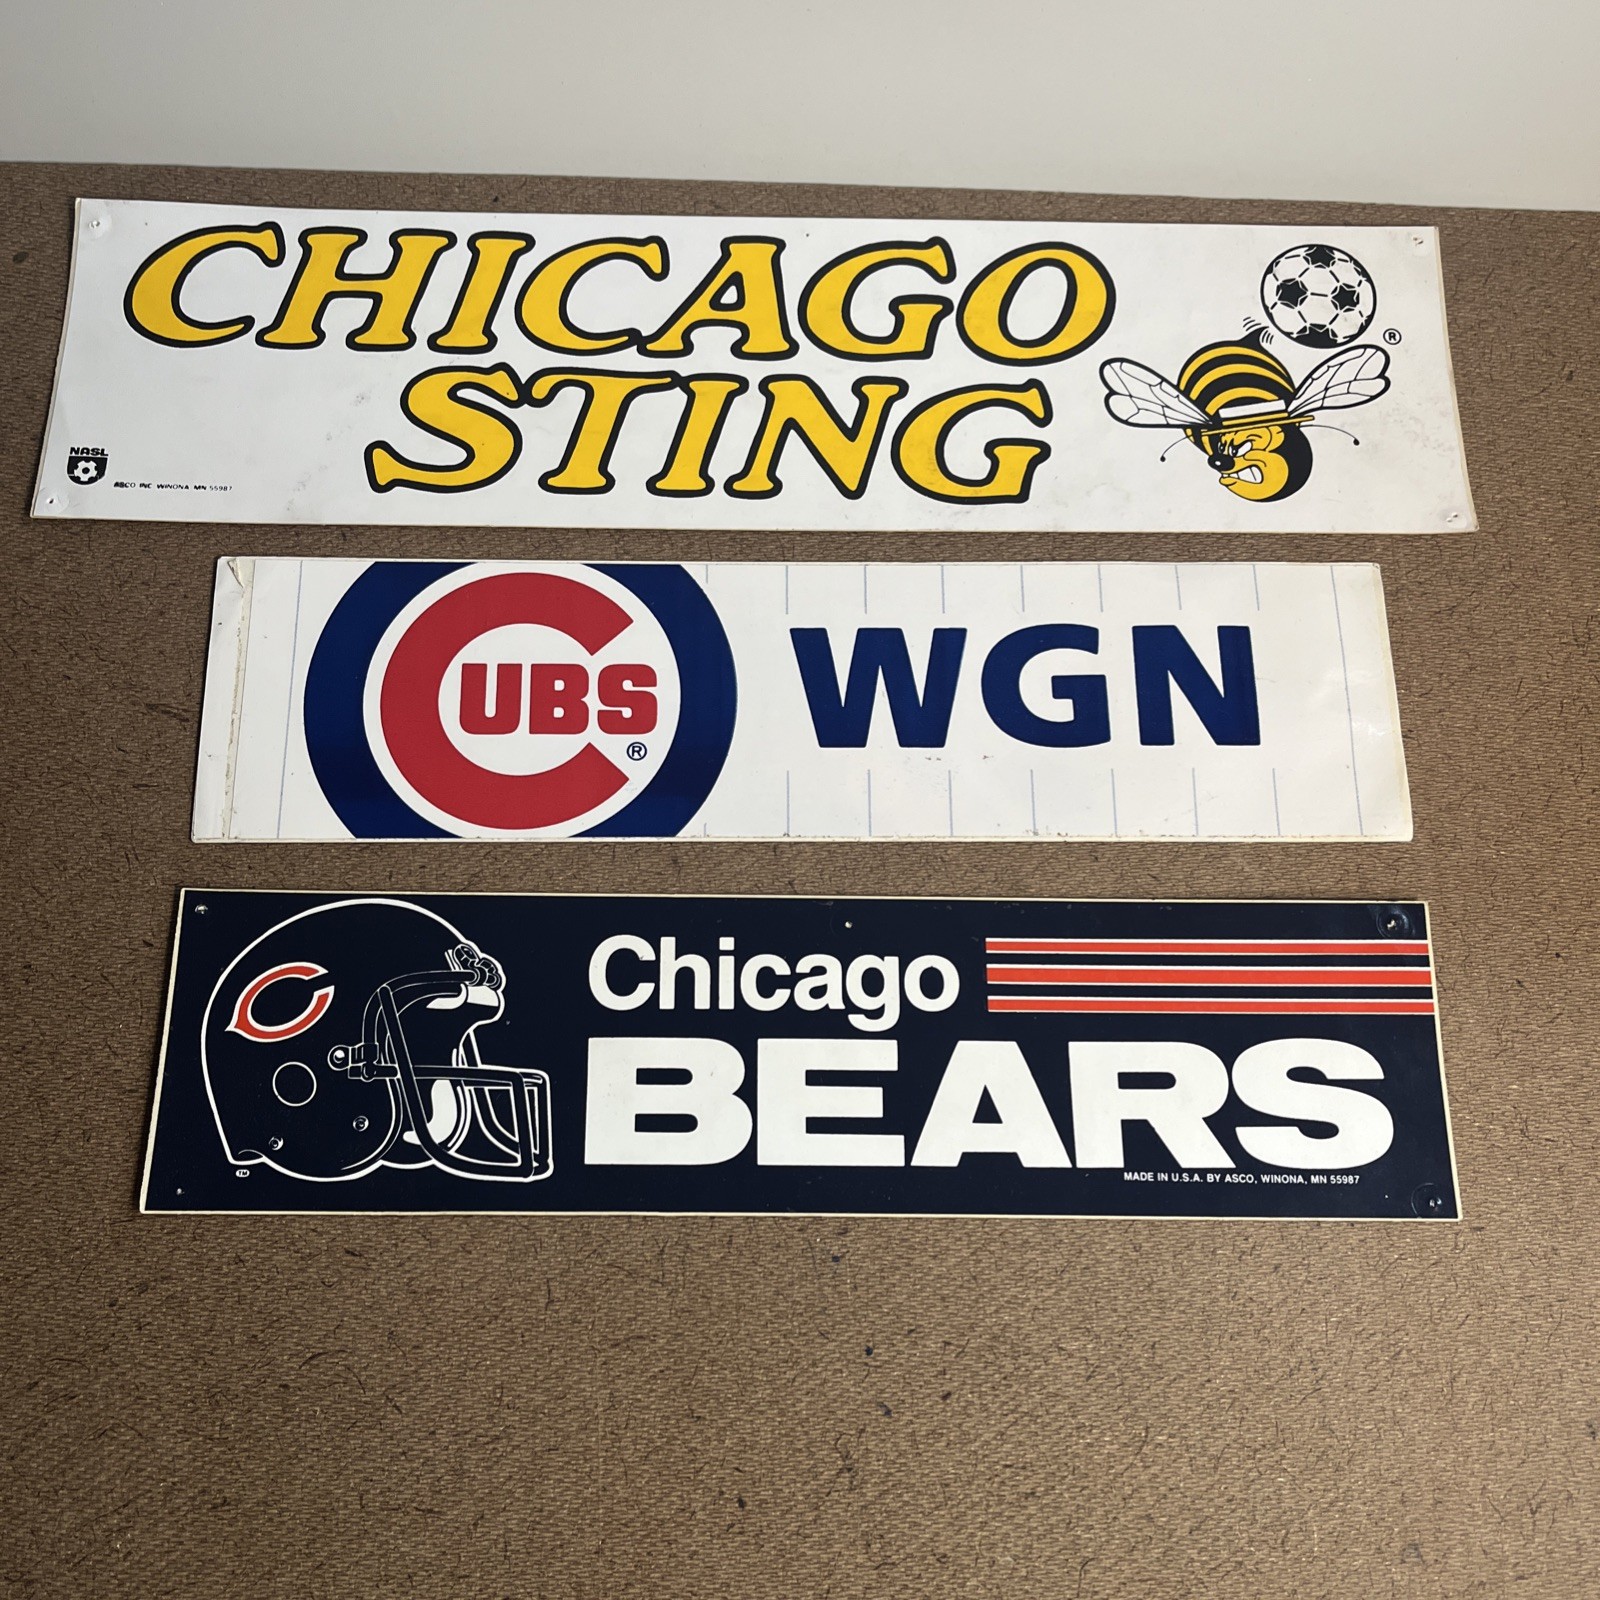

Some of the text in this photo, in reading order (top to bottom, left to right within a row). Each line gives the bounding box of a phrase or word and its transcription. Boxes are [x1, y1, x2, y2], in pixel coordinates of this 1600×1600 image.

[124, 221, 1117, 366] CHICAGO
[70, 446, 108, 456] NASL
[156, 483, 190, 491] WINONA
[364, 362, 1053, 504] STING
[789, 623, 1262, 748] WGN
[588, 934, 961, 1034] Chicago
[584, 1037, 1394, 1169] BEARS
[1123, 1172, 1360, 1186] MADE IN U.S.A. BY ASCO, WINONA, MN 55987
